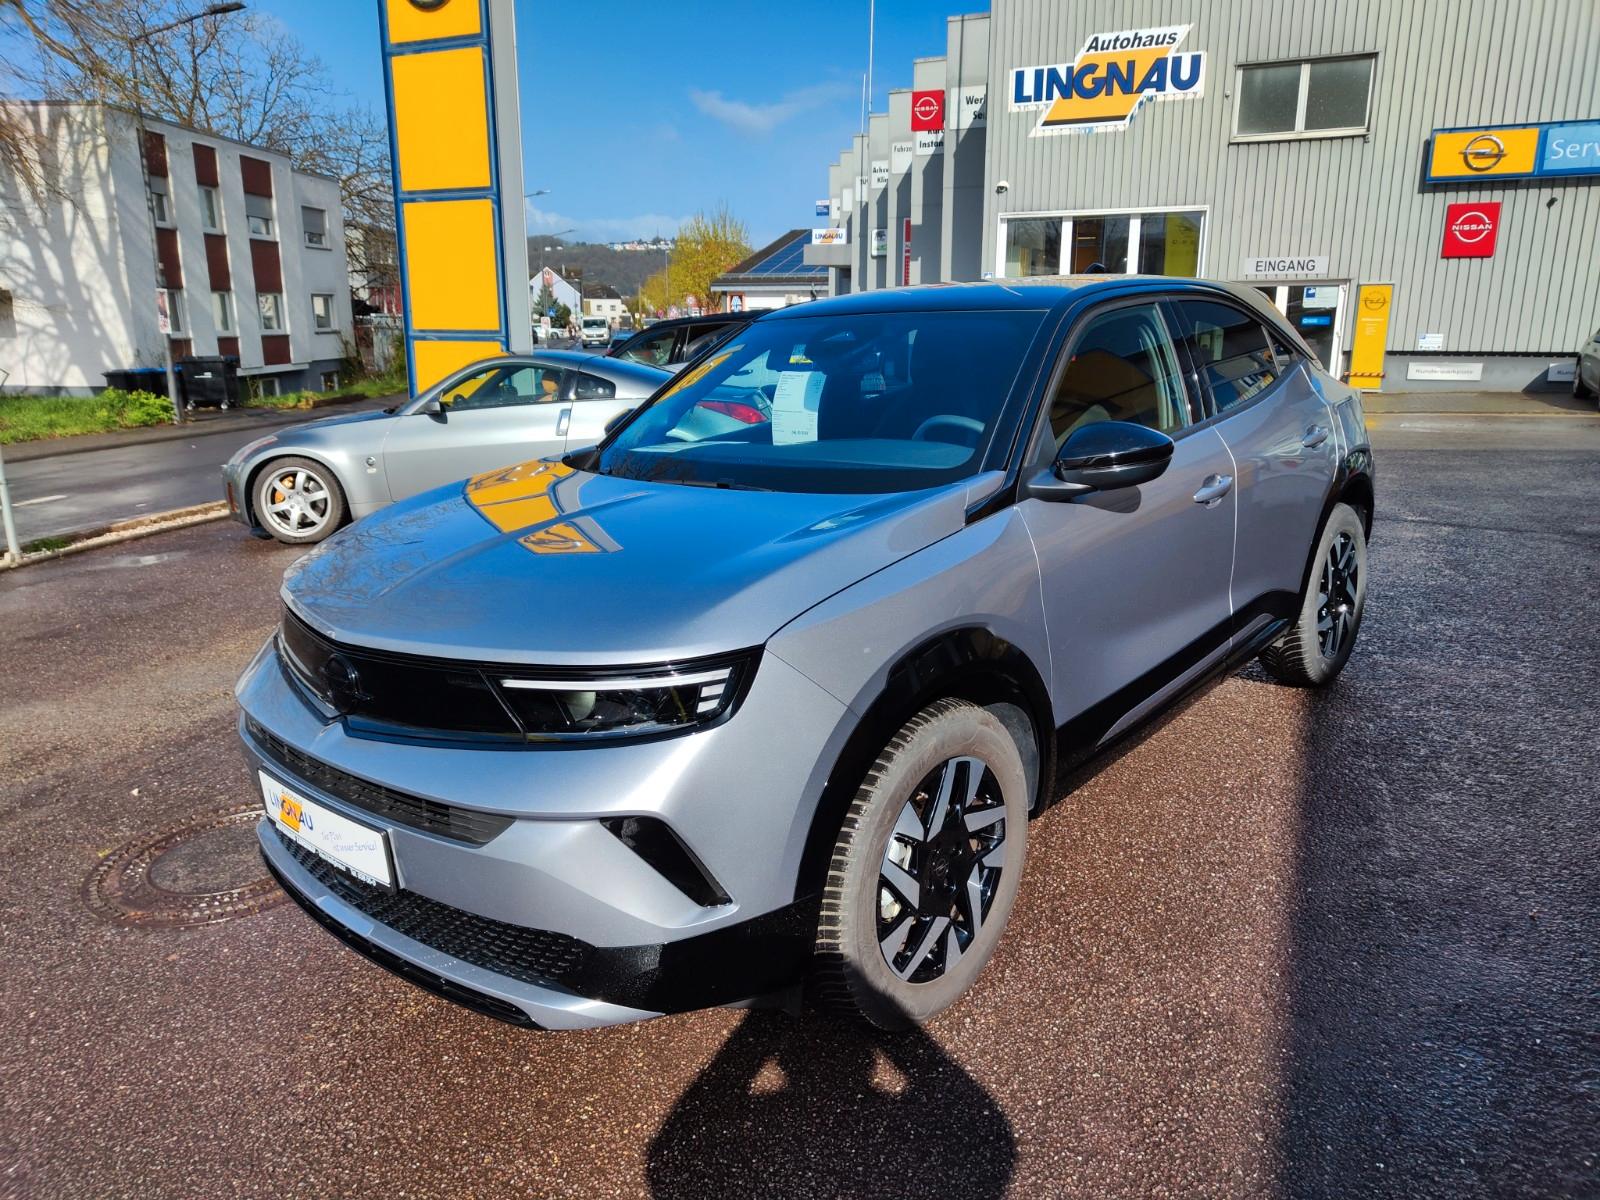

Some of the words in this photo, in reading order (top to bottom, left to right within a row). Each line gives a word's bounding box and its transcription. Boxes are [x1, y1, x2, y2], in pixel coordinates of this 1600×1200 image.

[1085, 31, 1178, 52] Autohaus
[1014, 54, 1202, 104] LINGNAU
[1452, 223, 1493, 231] NISSAN
[1255, 259, 1316, 273] EINGANG
